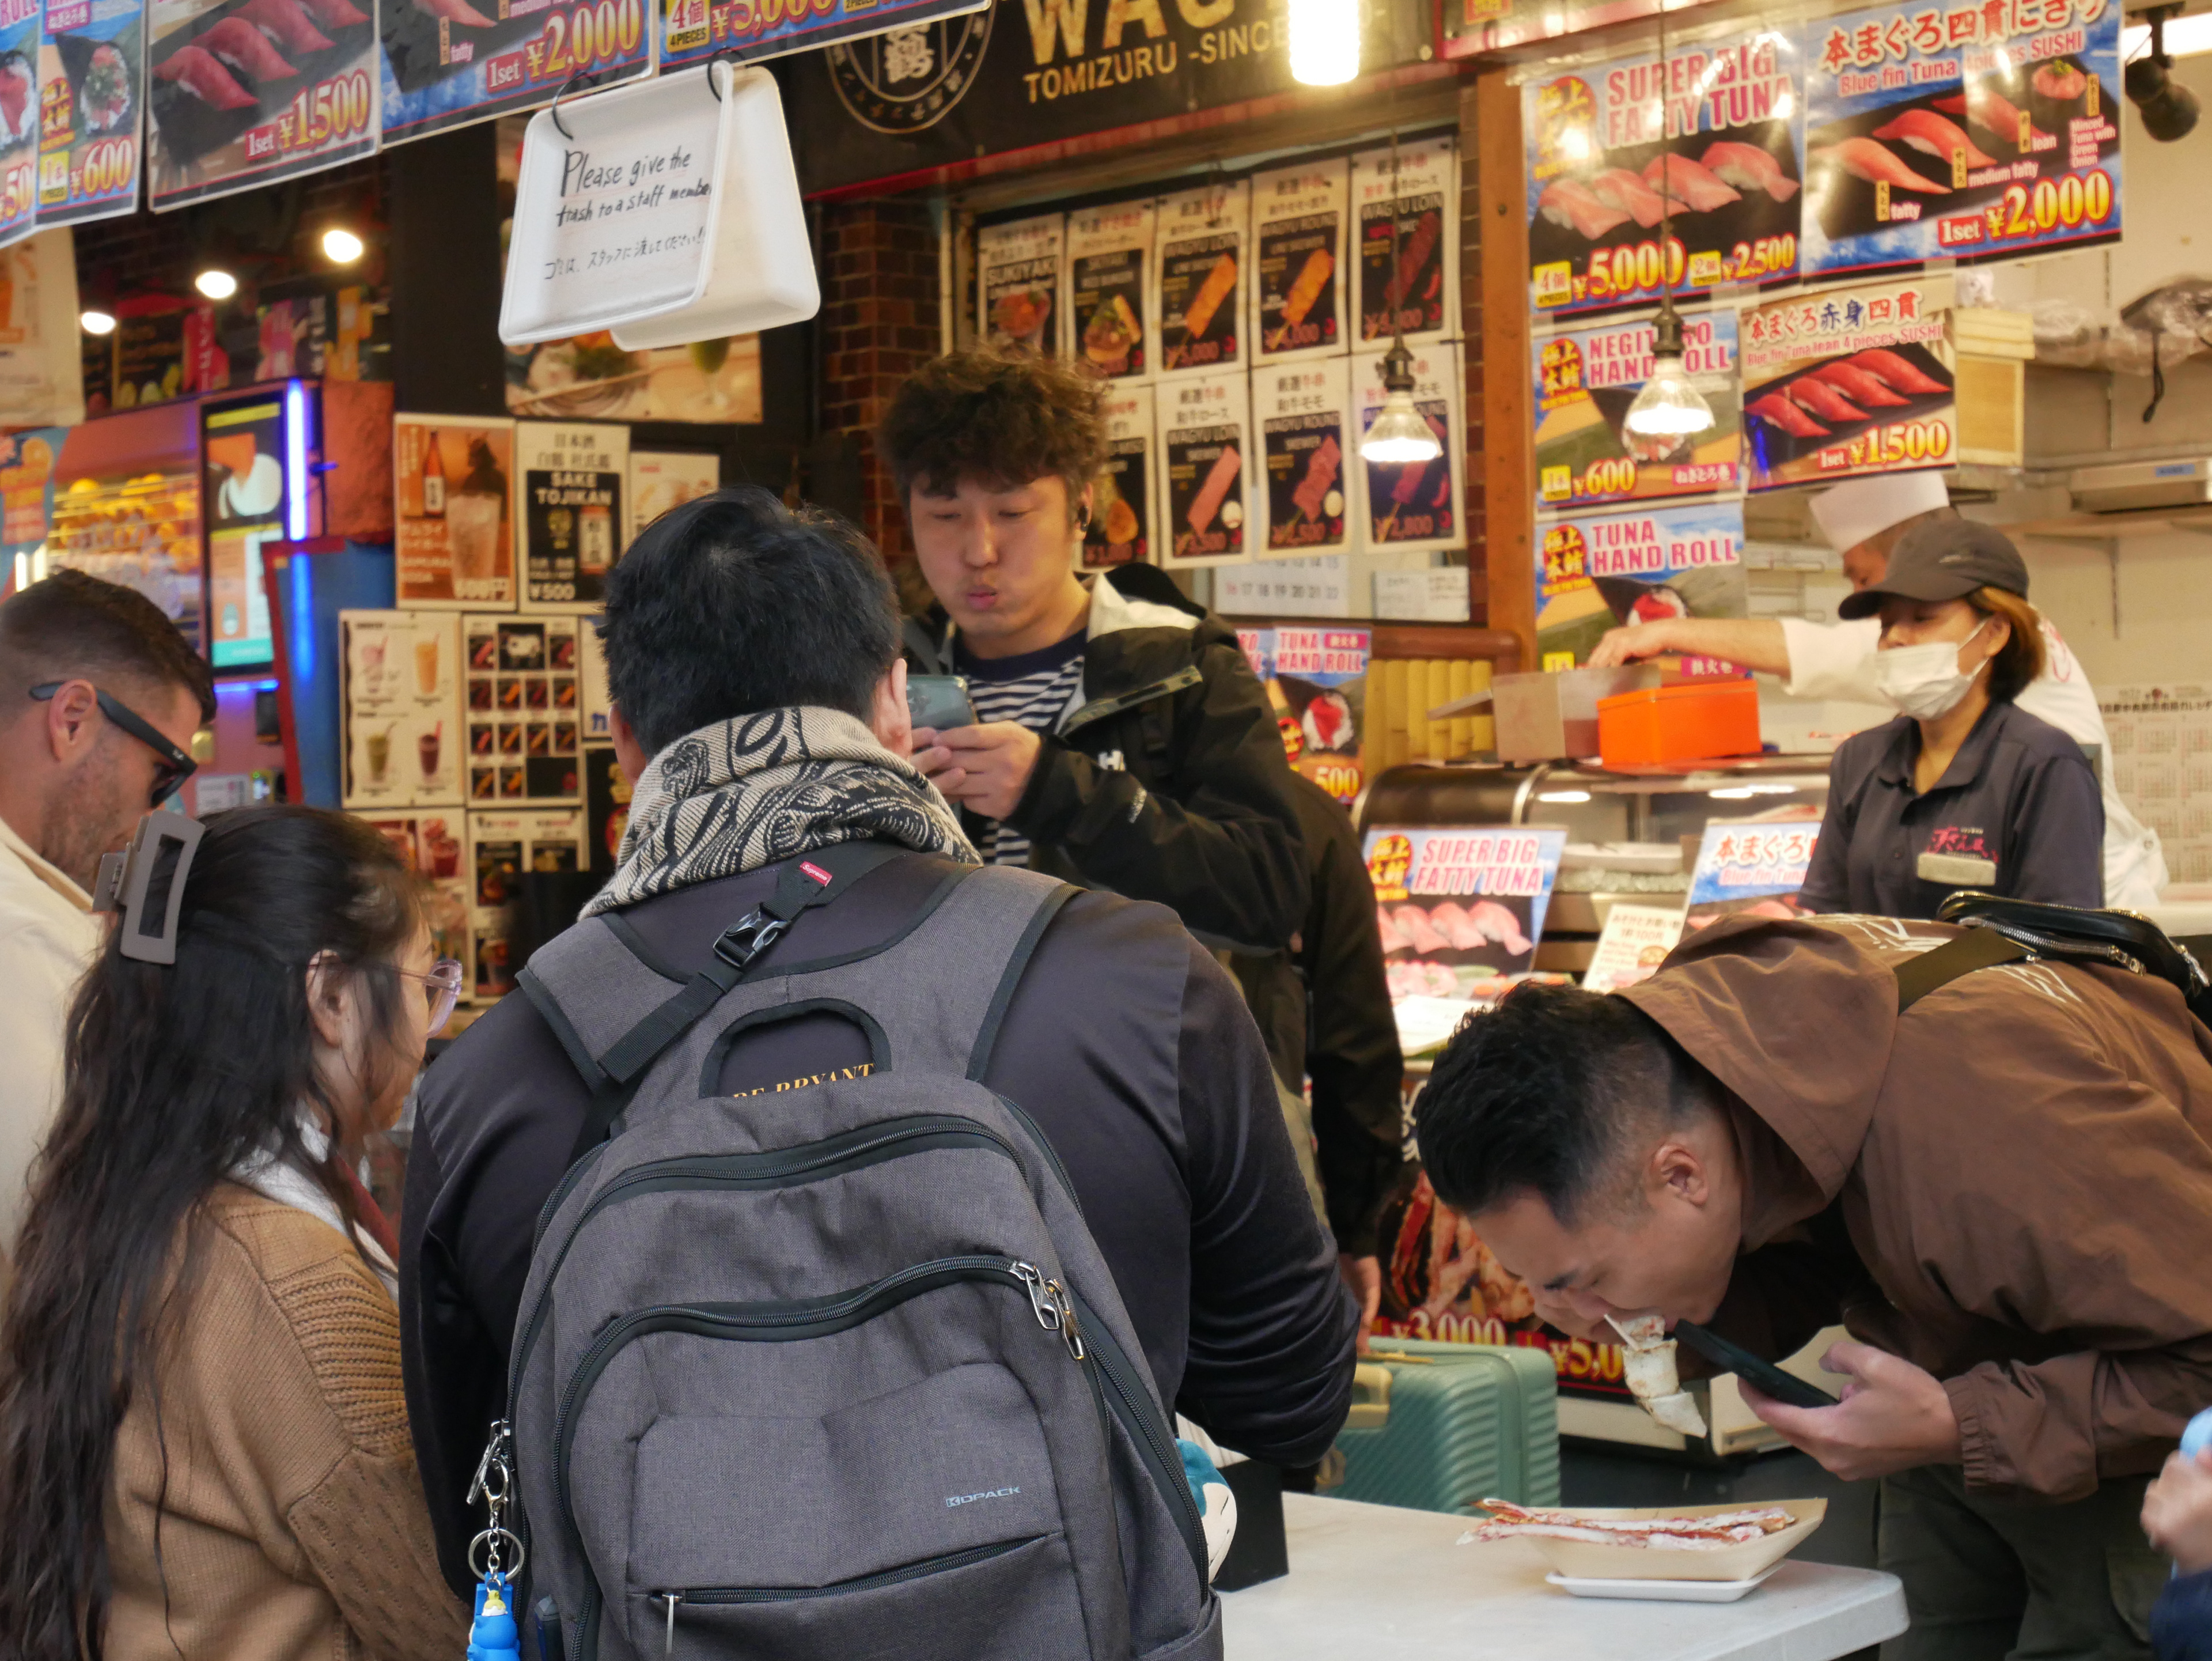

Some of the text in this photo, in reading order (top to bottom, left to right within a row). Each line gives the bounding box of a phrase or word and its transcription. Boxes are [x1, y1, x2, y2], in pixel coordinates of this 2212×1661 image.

[490, 0, 641, 88] 1set ¥2,000
[1023, 41, 1177, 103] TOMIZURU
[1608, 54, 1706, 107] SUPER
[1842, 71, 1877, 94] Blue
[1883, 67, 1906, 87] fin
[1911, 59, 1957, 81] Tuna
[2031, 31, 2084, 58] SUSHI
[279, 74, 368, 148] ¥1,500
[1608, 94, 1700, 145] FATY
[2032, 134, 2057, 152] lean
[70, 139, 132, 196] ¥600
[560, 145, 691, 197] Please give the
[1968, 160, 2039, 187] medium fatty
[556, 199, 593, 227] trash
[598, 203, 612, 220] to
[614, 199, 623, 212] a
[626, 184, 665, 211] staff
[1361, 198, 1410, 219] WAGU
[1891, 202, 1921, 221] fatty
[1942, 172, 2110, 243] 1set ¥2,000
[1574, 240, 1684, 300] ¥5,000
[1722, 234, 1796, 281] ¥2,500
[1843, 336, 1850, 348] 4
[1854, 332, 1896, 351] pieces
[1901, 324, 1943, 343] SUSHI
[1590, 355, 1656, 384] HAND
[1851, 421, 1948, 464] ¥1,500
[551, 472, 598, 488] SAKE
[1573, 459, 1635, 495] ¥600
[536, 489, 612, 506] TOJIKAN
[1593, 520, 1656, 547] TUNA
[1594, 538, 1736, 574] HAND ROLL
[1280, 632, 1319, 650] TUNA
[1279, 653, 1320, 671] HAND
[1327, 653, 1362, 671] ROLL
[1423, 838, 1539, 864] SUPER BIG
[1415, 867, 1482, 891] FATTY
[1483, 867, 1542, 892] TUNA
[1722, 868, 1750, 884] Blue
